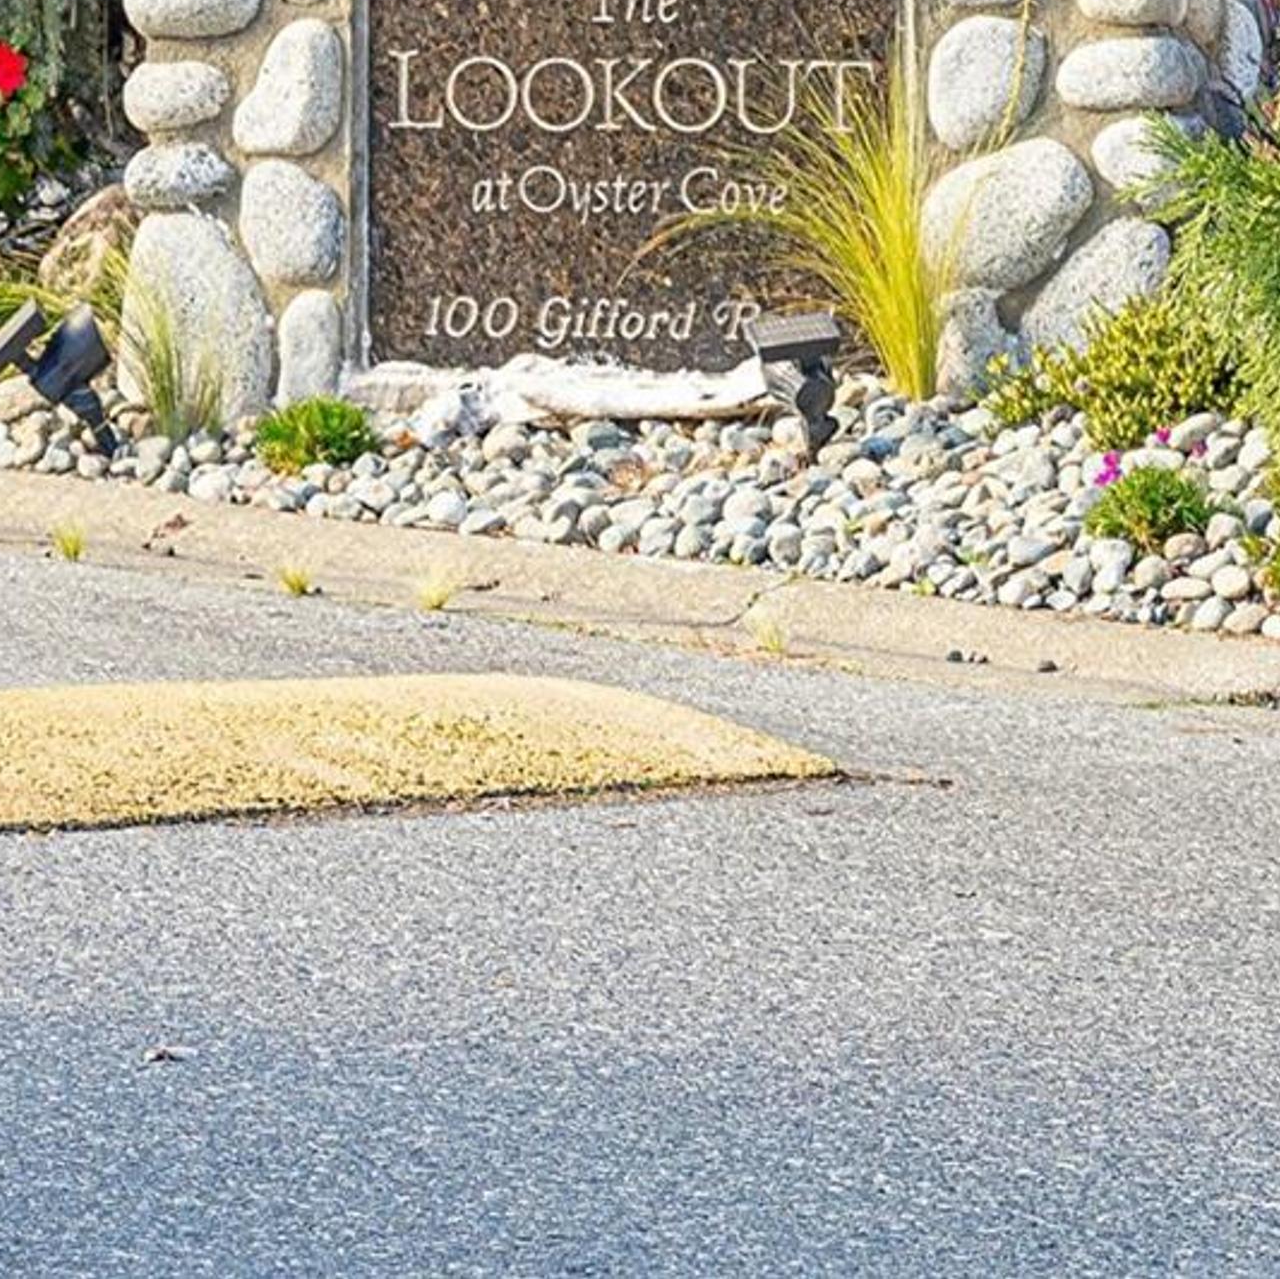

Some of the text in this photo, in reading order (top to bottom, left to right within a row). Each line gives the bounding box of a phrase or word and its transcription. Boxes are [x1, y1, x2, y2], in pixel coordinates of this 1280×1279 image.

[386, 48, 875, 134] LOOKOUT
[472, 166, 789, 223] at Oyster Cove
[424, 295, 762, 349] 100 Gifford R
